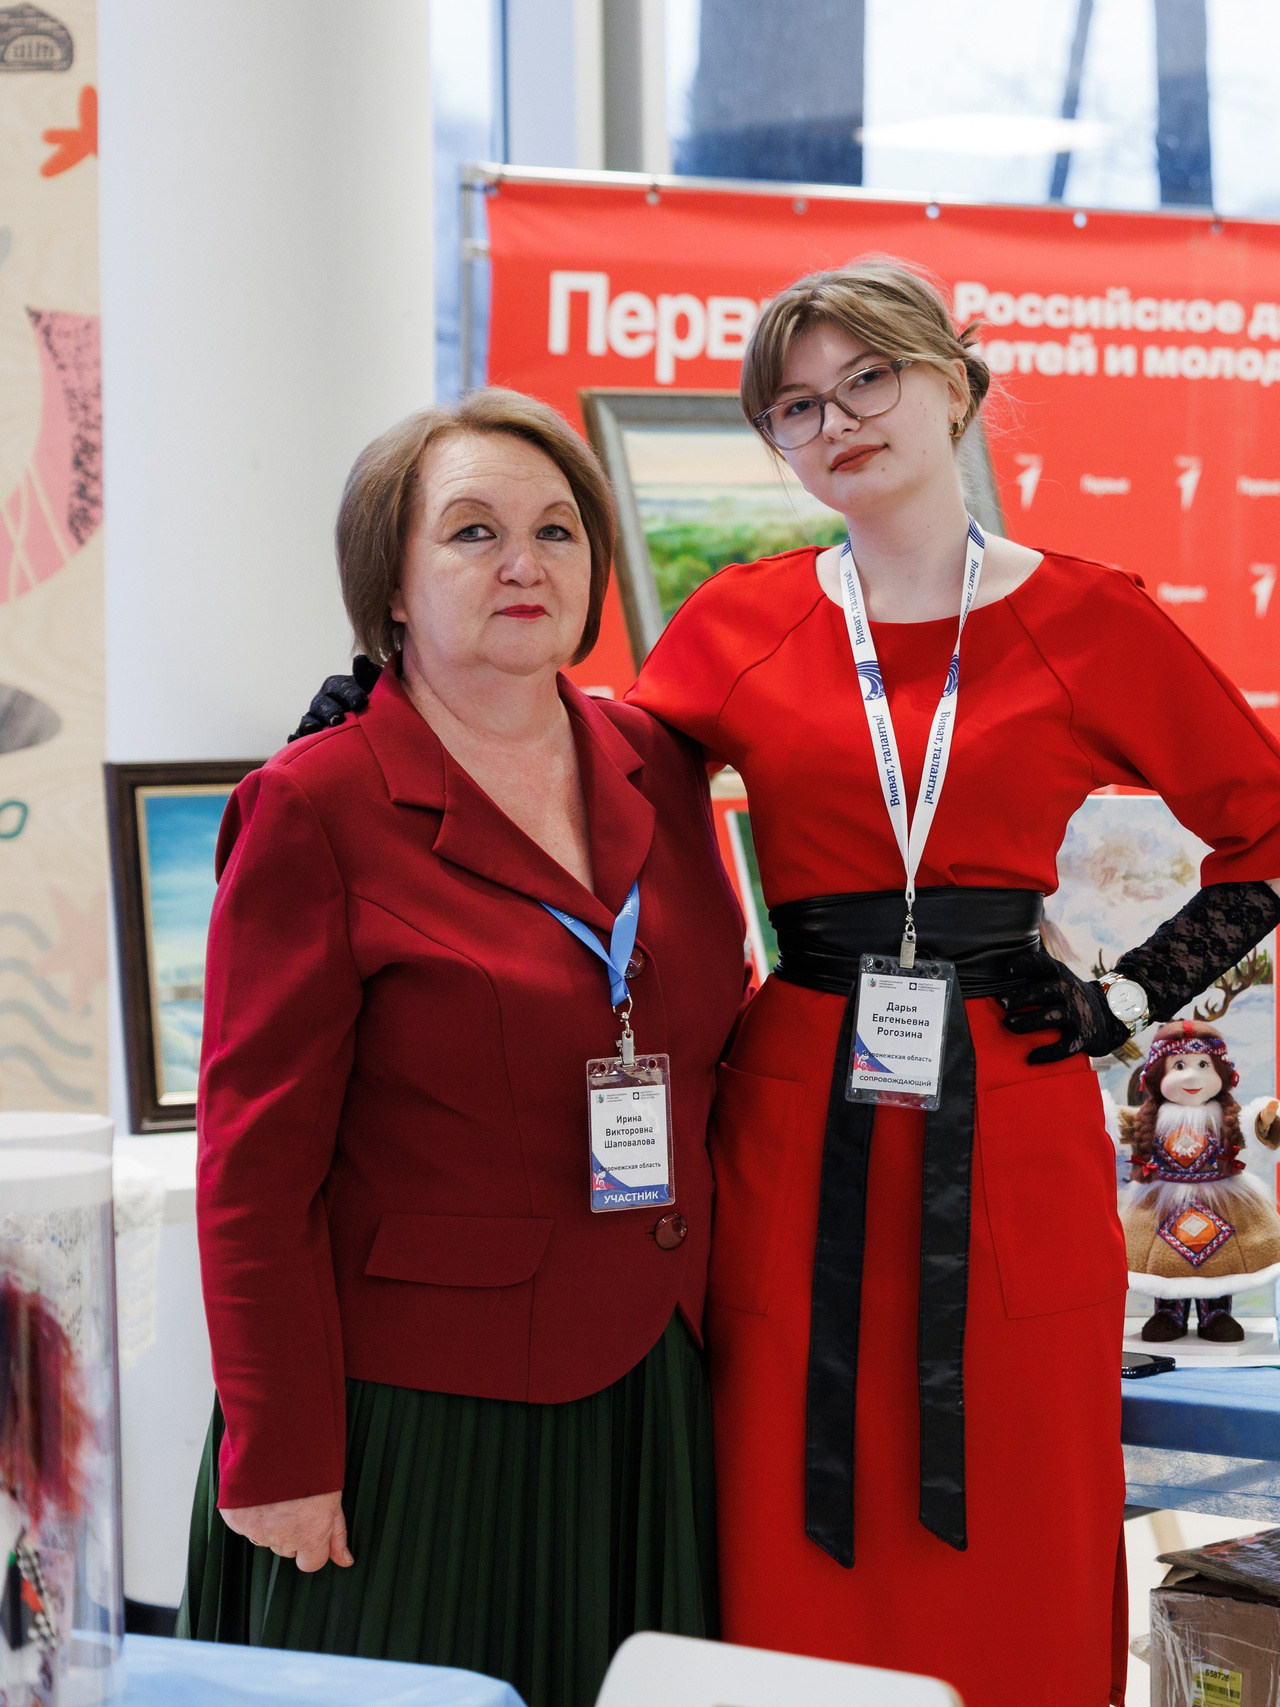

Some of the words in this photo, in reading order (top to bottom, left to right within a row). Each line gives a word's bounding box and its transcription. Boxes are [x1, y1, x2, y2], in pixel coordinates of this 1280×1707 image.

[952, 282, 1245, 335] Российское
[548, 270, 772, 384] Перв
[1104, 345, 1136, 377] и
[933, 710, 951, 745] Виват,
[872, 714, 893, 765] таланты!
[924, 747, 943, 805] таланты!
[885, 765, 901, 807] Виват,
[886, 1001, 917, 1013] Дарья
[872, 1013, 930, 1027] Евгеньевна
[877, 1027, 923, 1039] Рогозина
[859, 1075, 932, 1087] СОПРОВОЖДАЮЩИЙ
[616, 1114, 642, 1125] Ирина
[605, 1126, 654, 1138] Викторовна
[604, 1138, 656, 1149] Шаповалова
[604, 1190, 659, 1204] УЧАСТНИК
